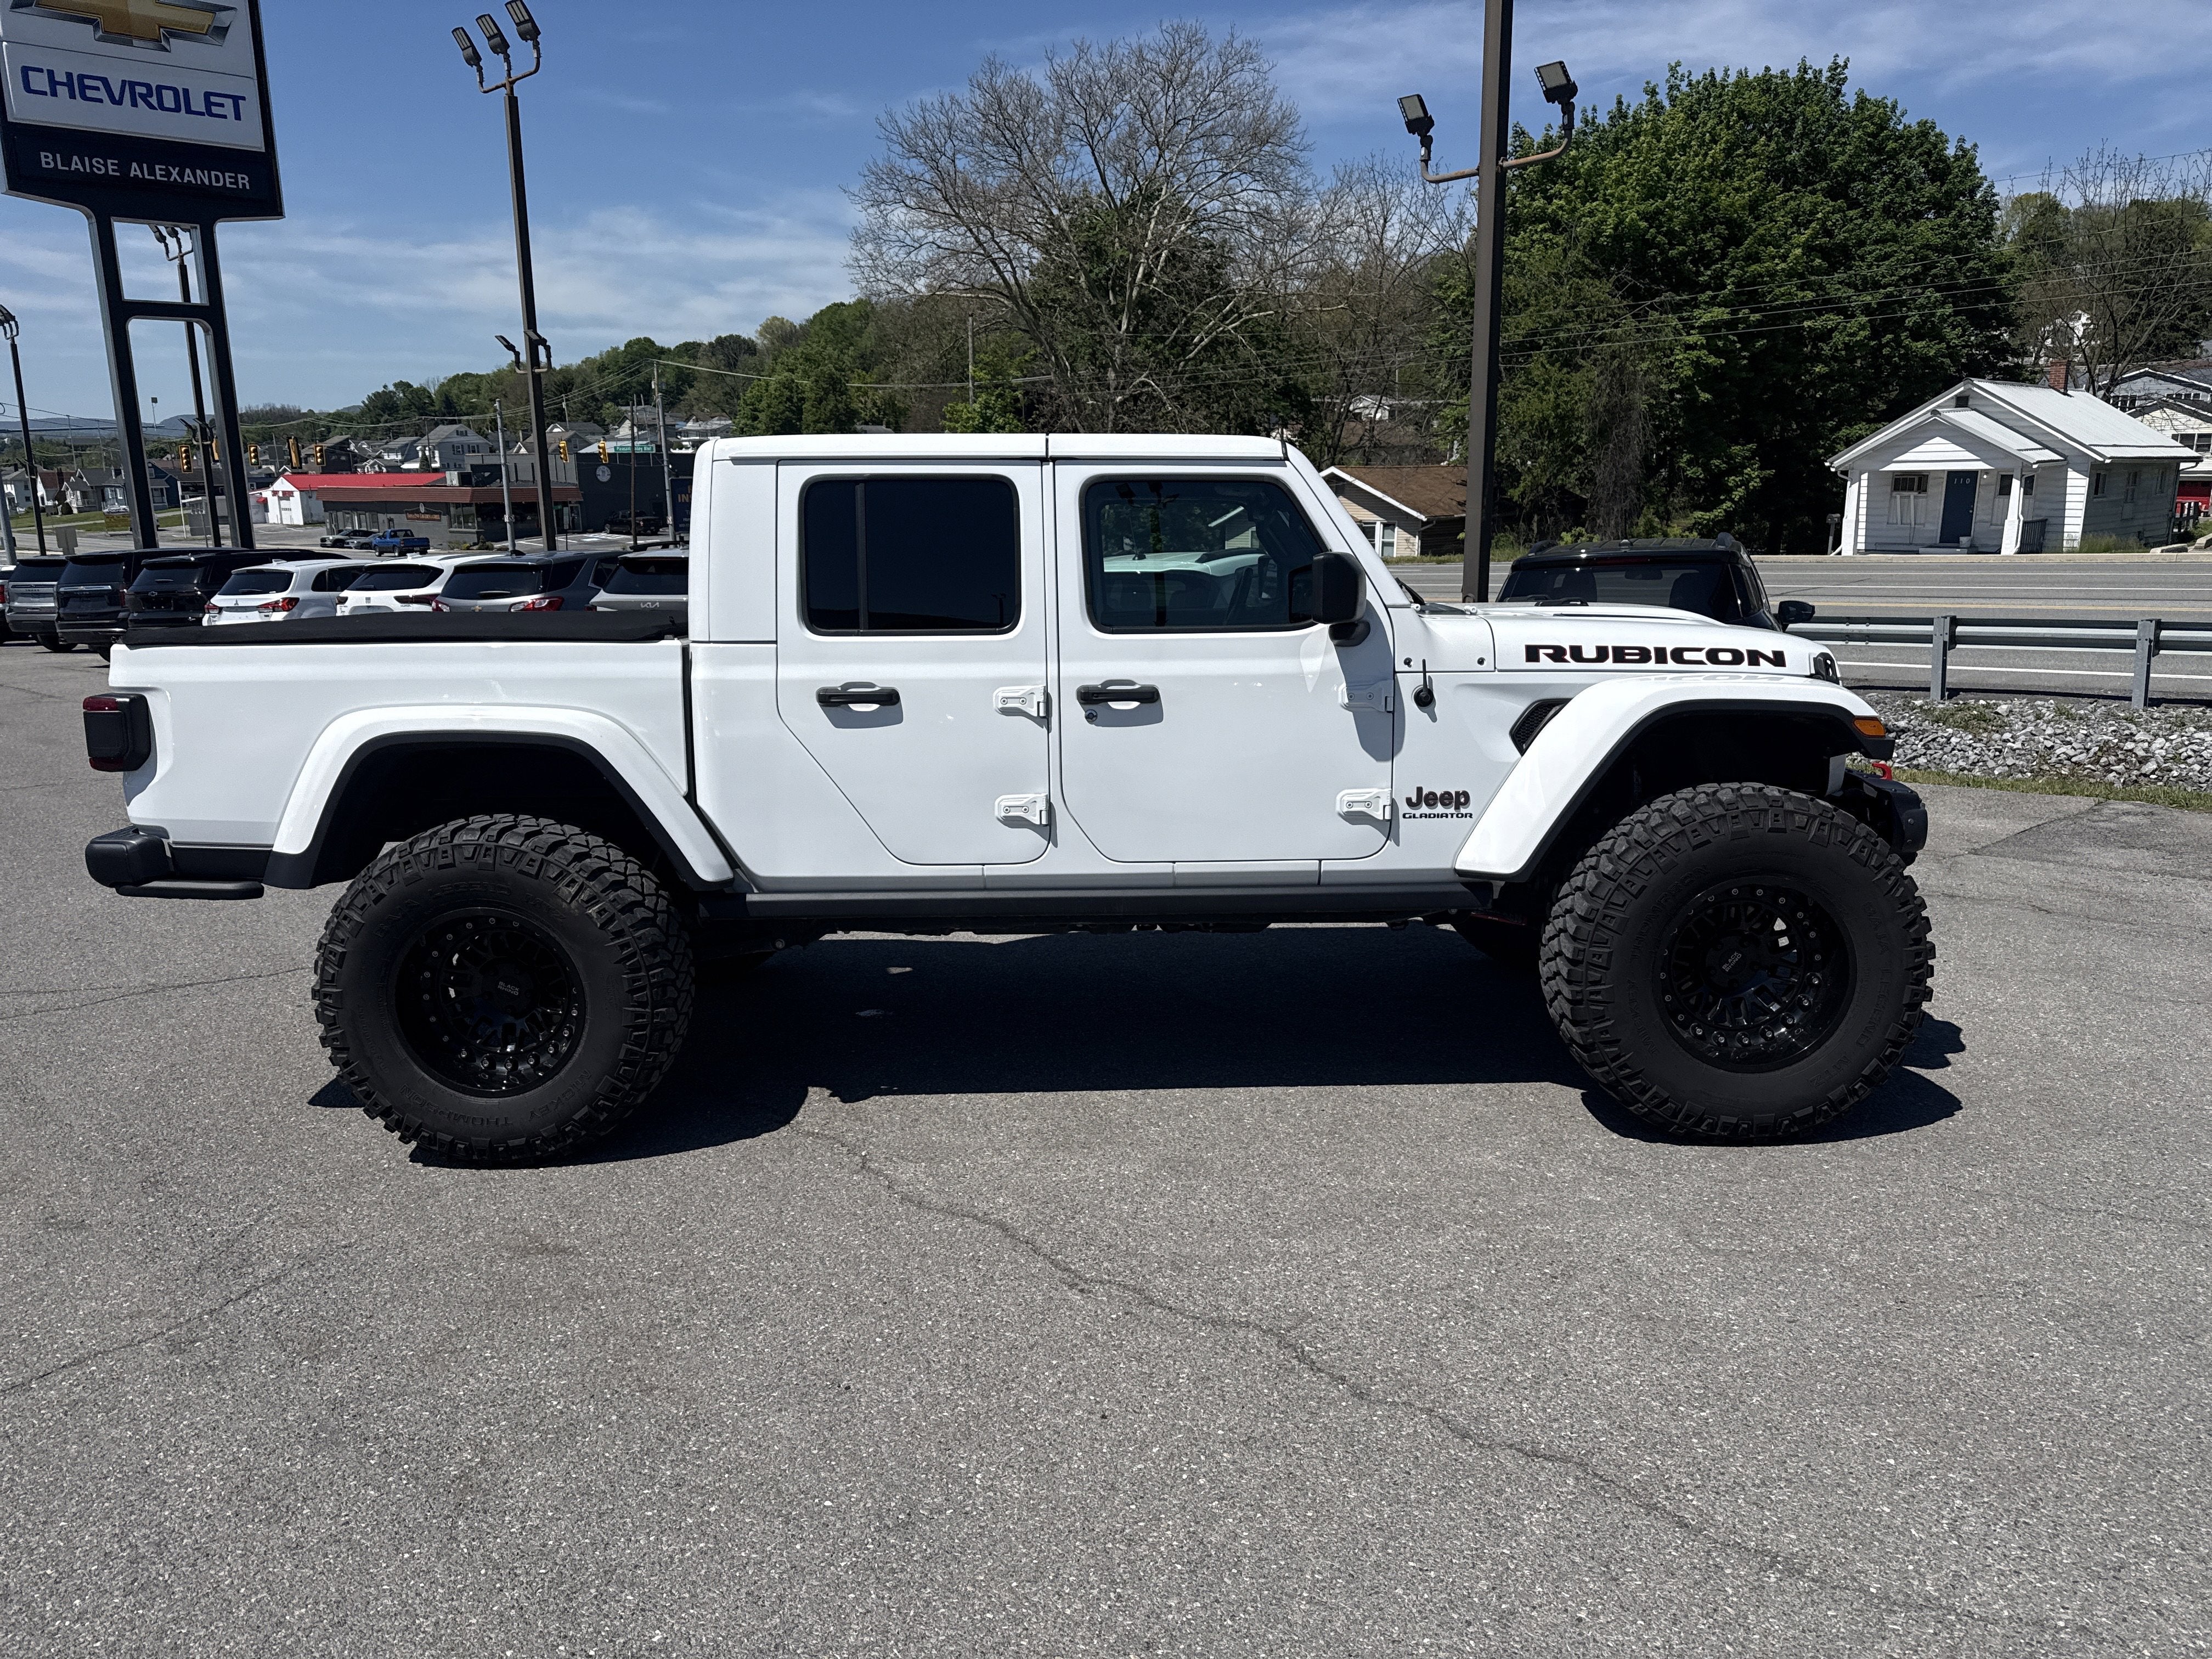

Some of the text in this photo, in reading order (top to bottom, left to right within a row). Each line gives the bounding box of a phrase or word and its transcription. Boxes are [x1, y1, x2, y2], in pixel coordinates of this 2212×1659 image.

[20, 65, 246, 121] CHEVROLET
[40, 151, 250, 190] BLAISE ALEXANDER
[1525, 644, 1787, 668] RUBICON
[1406, 786, 1471, 812] Jeep
[1722, 951, 1739, 969] BLACK
[1725, 953, 1742, 972] RHINO
[498, 985, 519, 996] RHINO
[499, 981, 520, 992] BLACK
